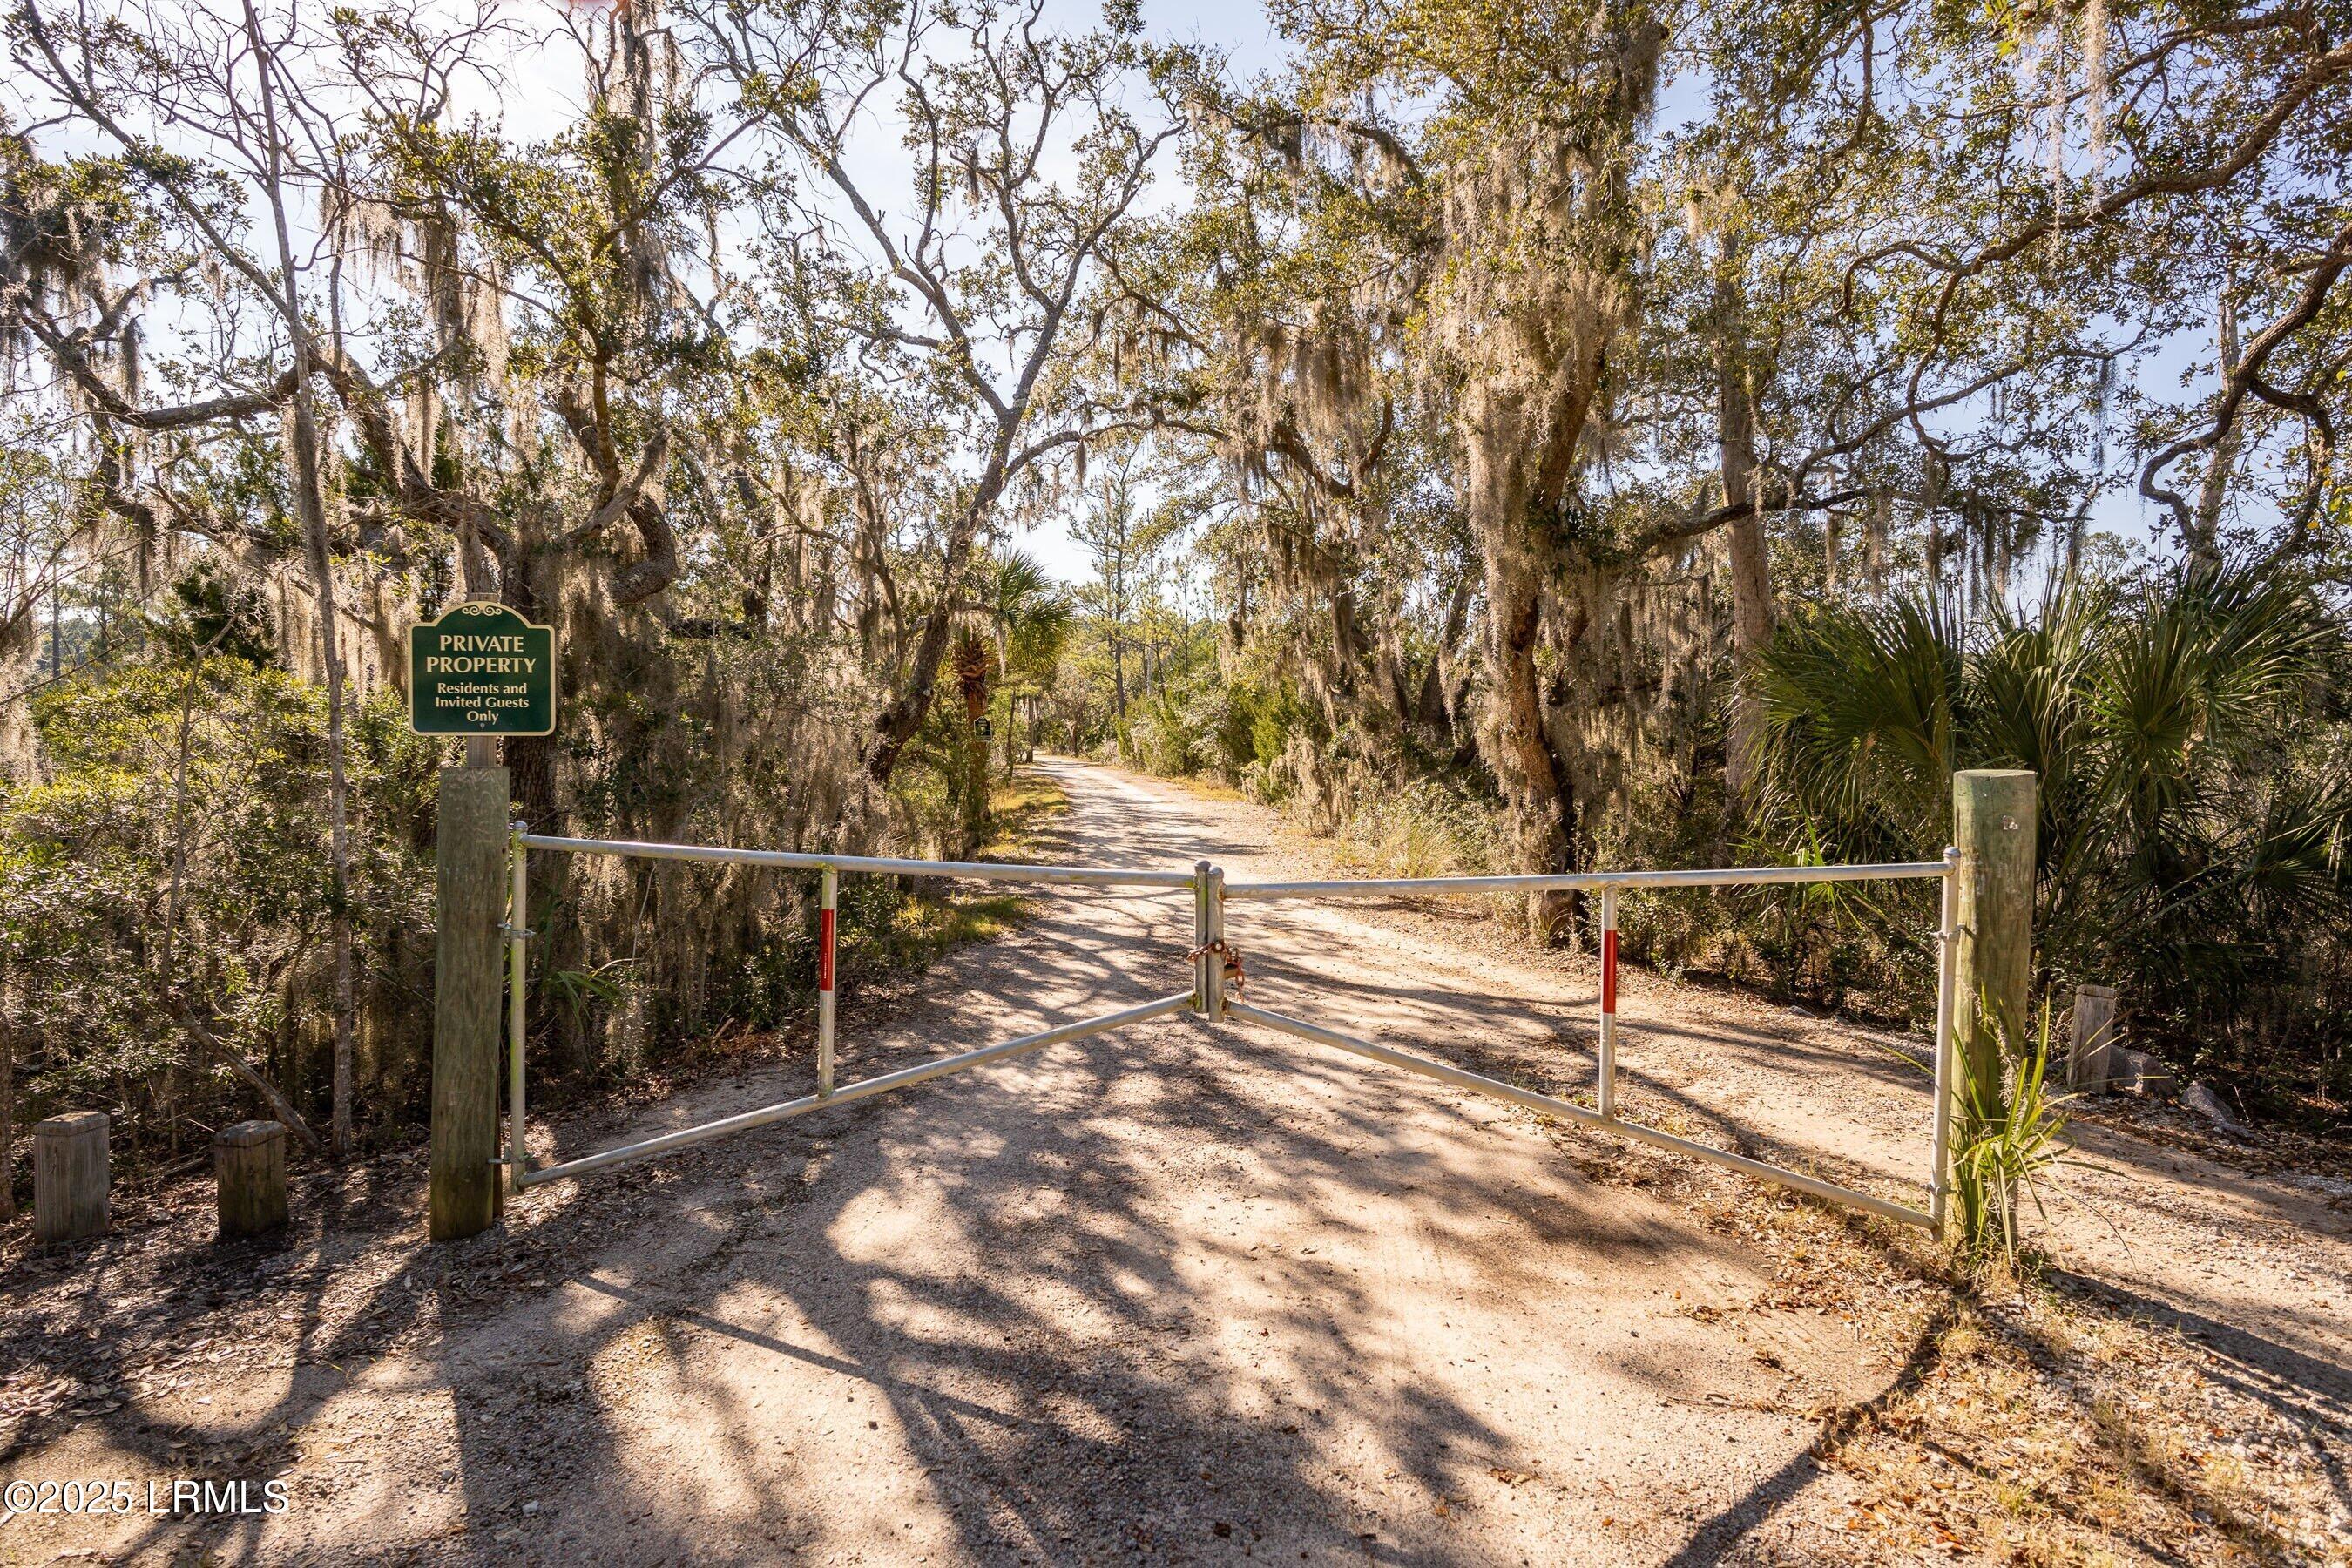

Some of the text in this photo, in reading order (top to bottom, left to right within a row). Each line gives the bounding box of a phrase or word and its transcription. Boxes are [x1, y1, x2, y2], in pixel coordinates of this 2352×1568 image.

[440, 635, 524, 652] PRIVATE
[426, 656, 537, 673] PROPERTY
[437, 682, 527, 694] Residents and
[436, 697, 530, 707] Invited Guests
[466, 710, 499, 725] Only
